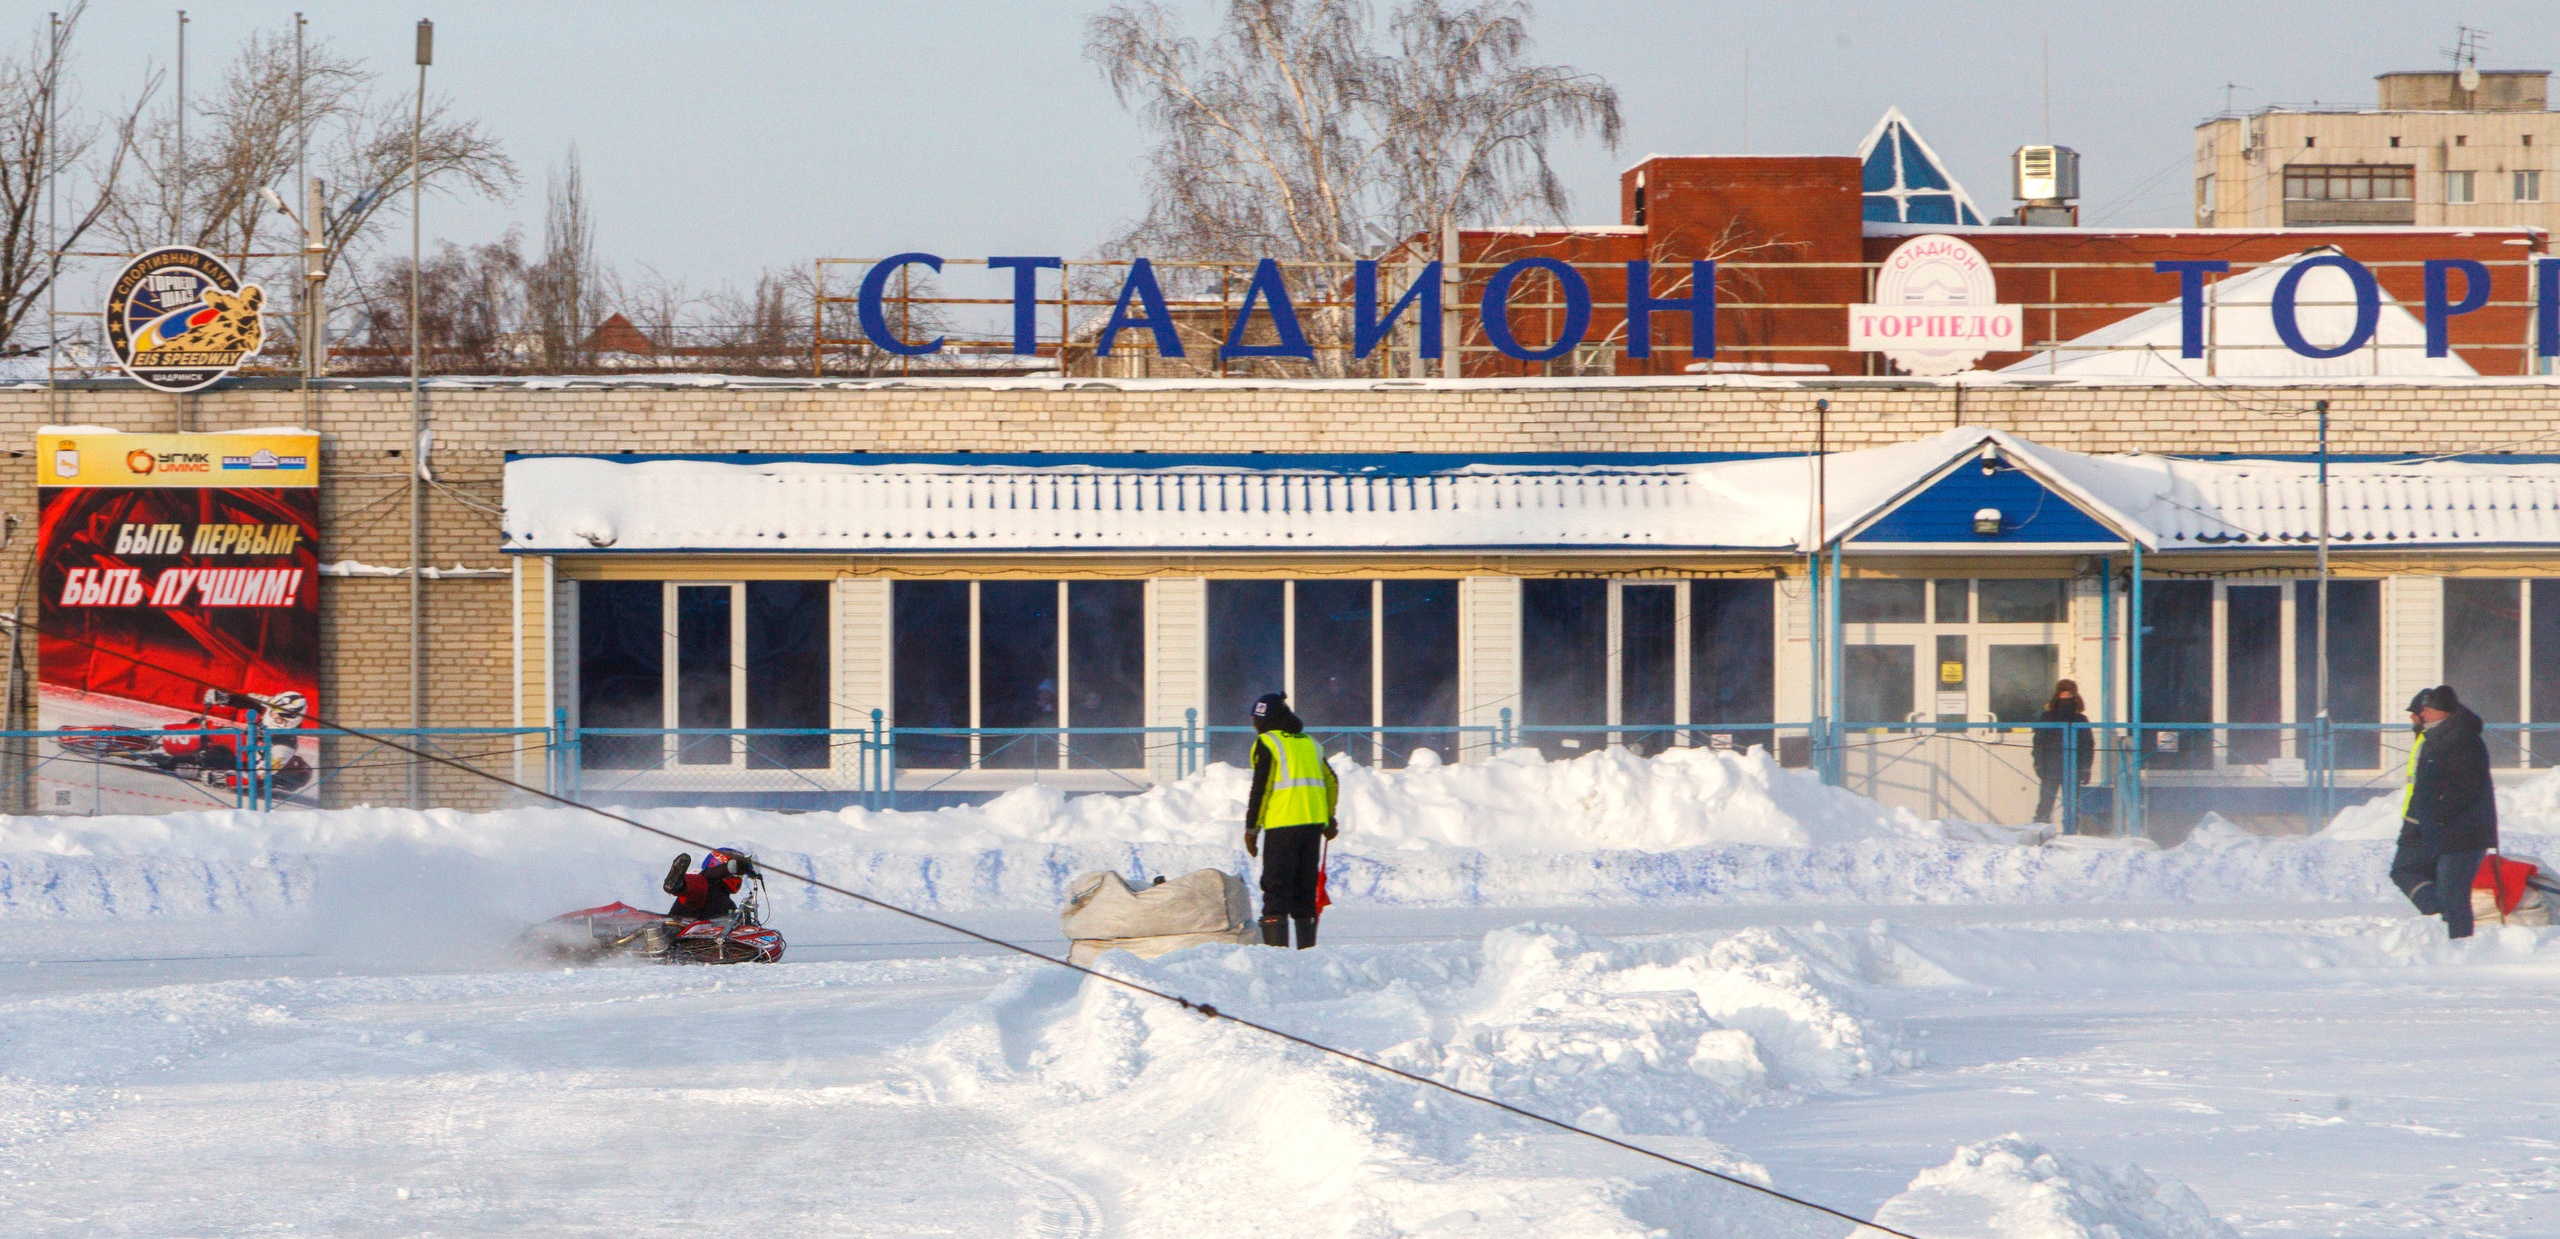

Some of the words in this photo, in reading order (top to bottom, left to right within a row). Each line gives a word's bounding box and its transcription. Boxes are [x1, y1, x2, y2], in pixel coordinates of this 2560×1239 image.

[1895, 241, 1980, 271] СТАДИОН
[117, 252, 200, 295] СПОРТИВНЫЙ
[202, 262, 230, 289] КЛУБ
[857, 252, 1716, 360] СТАДИОН
[2154, 255, 2560, 359] ТОР
[1858, 316, 2013, 342] ТОРПЕДО
[134, 353, 160, 366] EIS
[162, 352, 241, 365] SPEEDWAY
[152, 373, 203, 382] ШАДРИНСК
[158, 453, 209, 463] УГМК
[158, 463, 210, 473] UMMC
[115, 523, 184, 555] БЫТЬ
[190, 523, 303, 555] ПЕРВЫМ-
[61, 569, 143, 606] БЫТЬ
[150, 569, 303, 606] ЛУЧШИМ!
